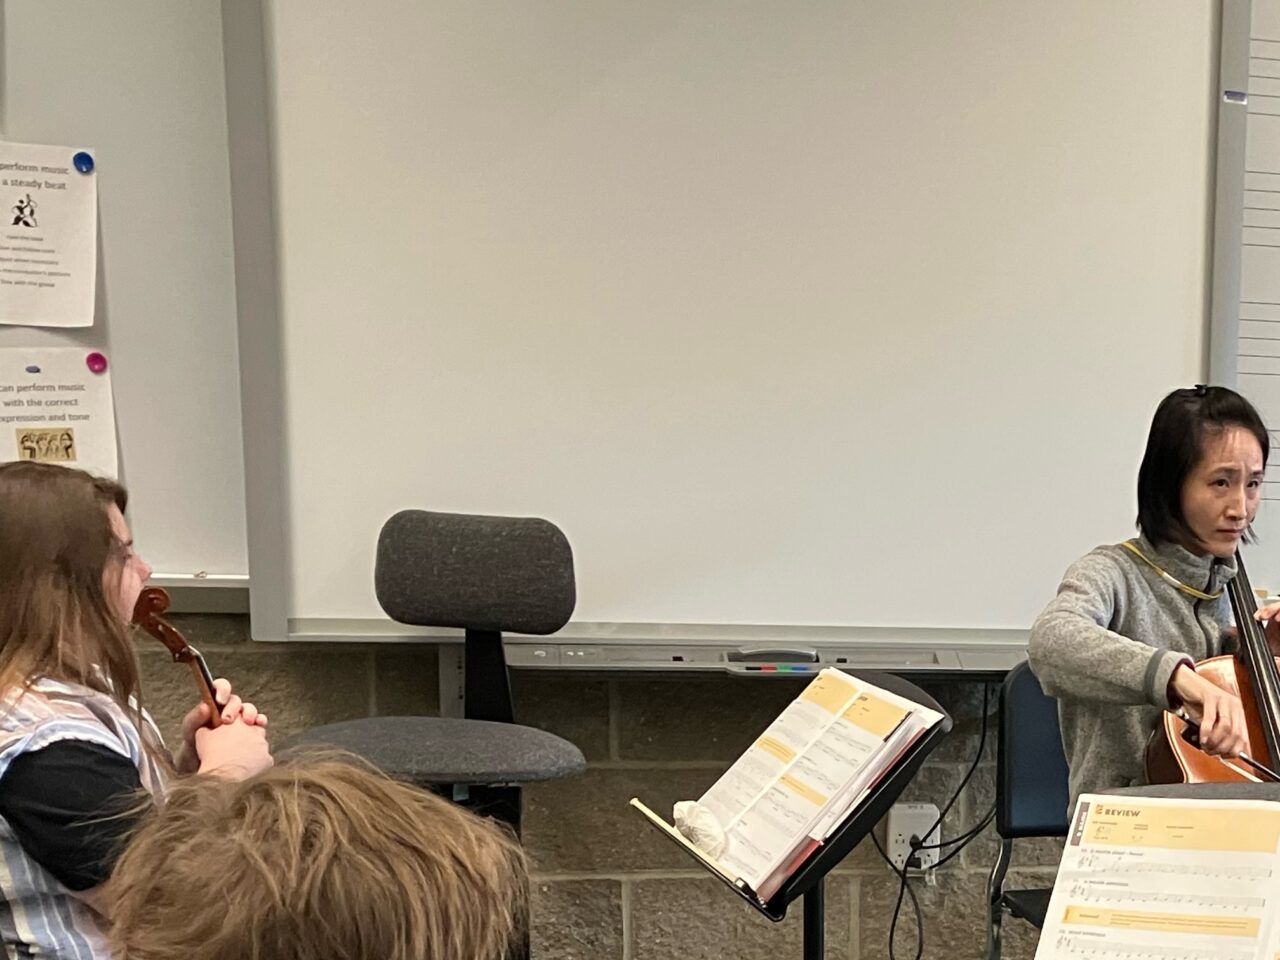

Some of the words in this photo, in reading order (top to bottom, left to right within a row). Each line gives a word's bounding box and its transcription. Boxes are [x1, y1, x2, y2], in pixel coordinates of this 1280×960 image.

[0, 162, 38, 173] perform
[41, 166, 70, 175] music
[2, 179, 8, 187] a
[10, 178, 42, 190] steady
[45, 180, 66, 191] beat
[17, 383, 56, 394] perform
[58, 384, 86, 392] music
[4, 398, 24, 406] with
[27, 398, 42, 406] the
[45, 398, 78, 406] correct
[48, 414, 66, 422] and
[1104, 808, 1142, 818] REVIEW
